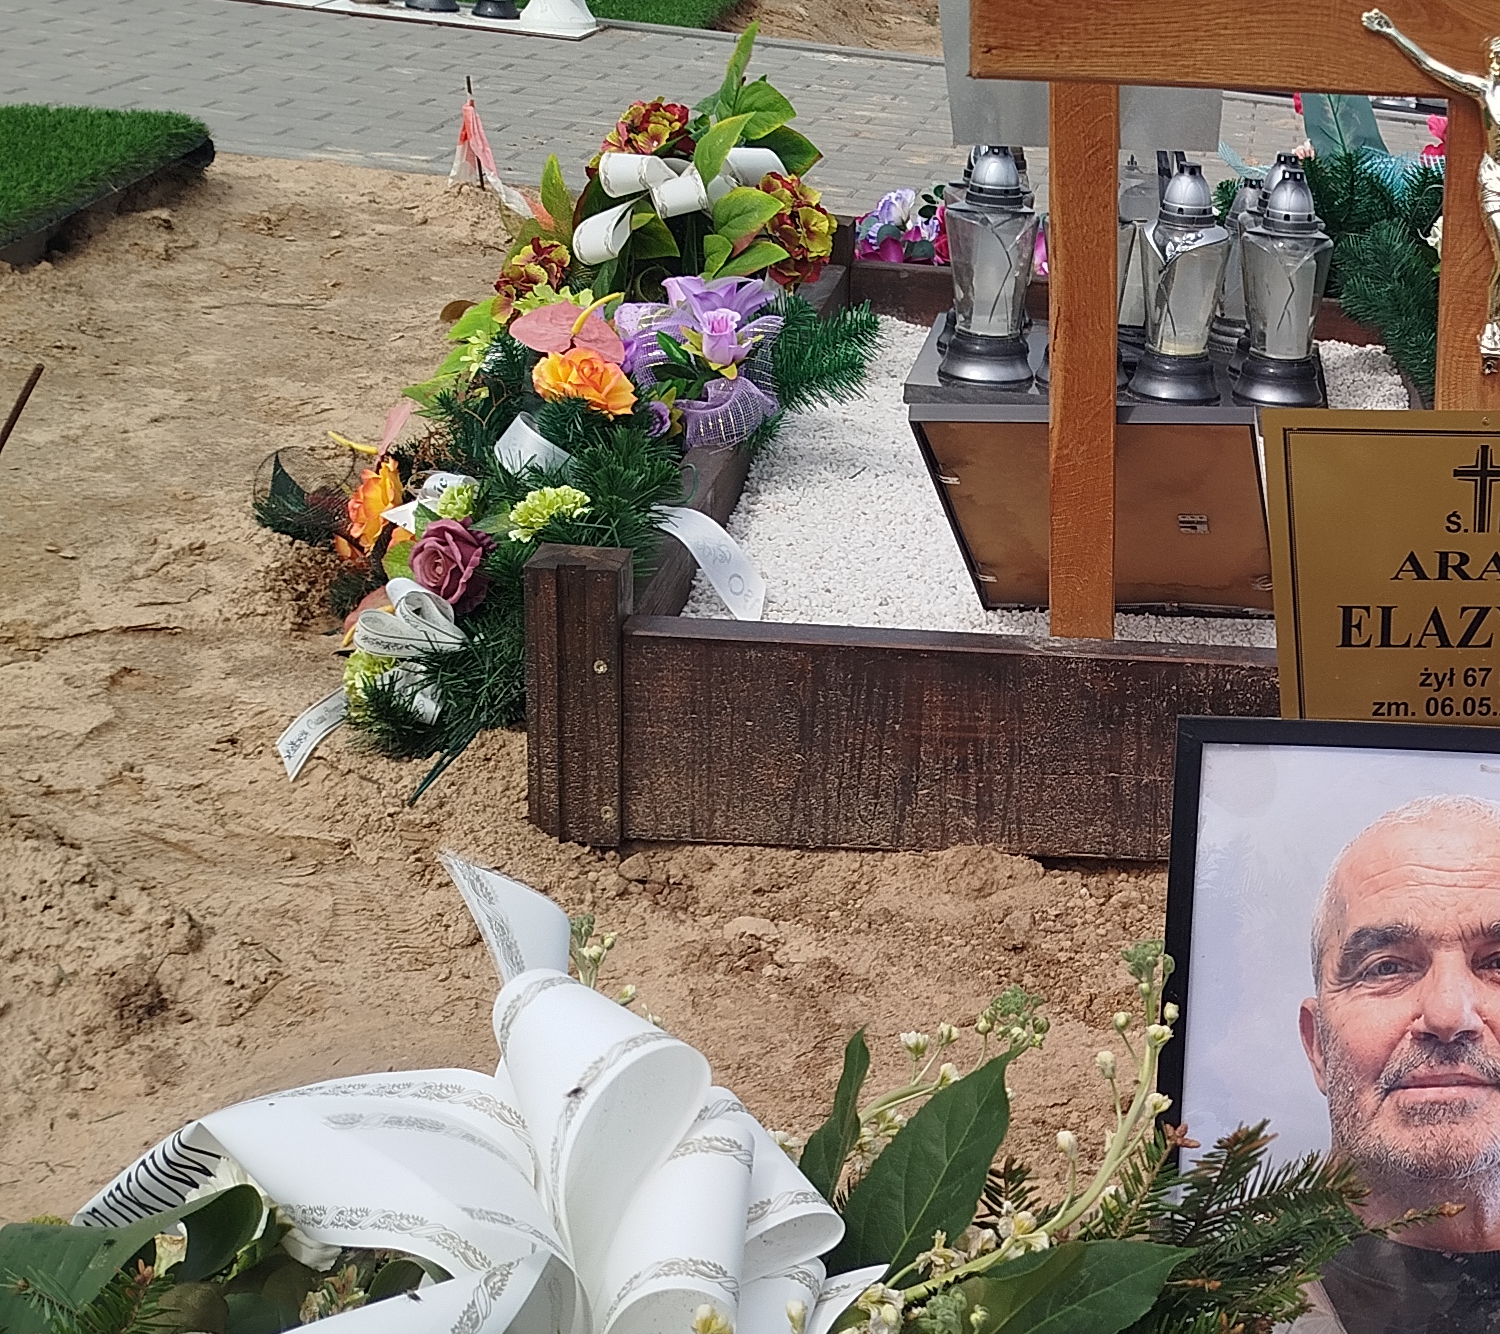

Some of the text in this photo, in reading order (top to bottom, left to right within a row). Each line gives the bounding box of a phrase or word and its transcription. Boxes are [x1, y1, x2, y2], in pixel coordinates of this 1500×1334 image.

[1445, 510, 1469, 534] Ś.
[1419, 667, 1456, 693] żył
[1463, 667, 1493, 688] 67
[1372, 701, 1416, 717] zm.
